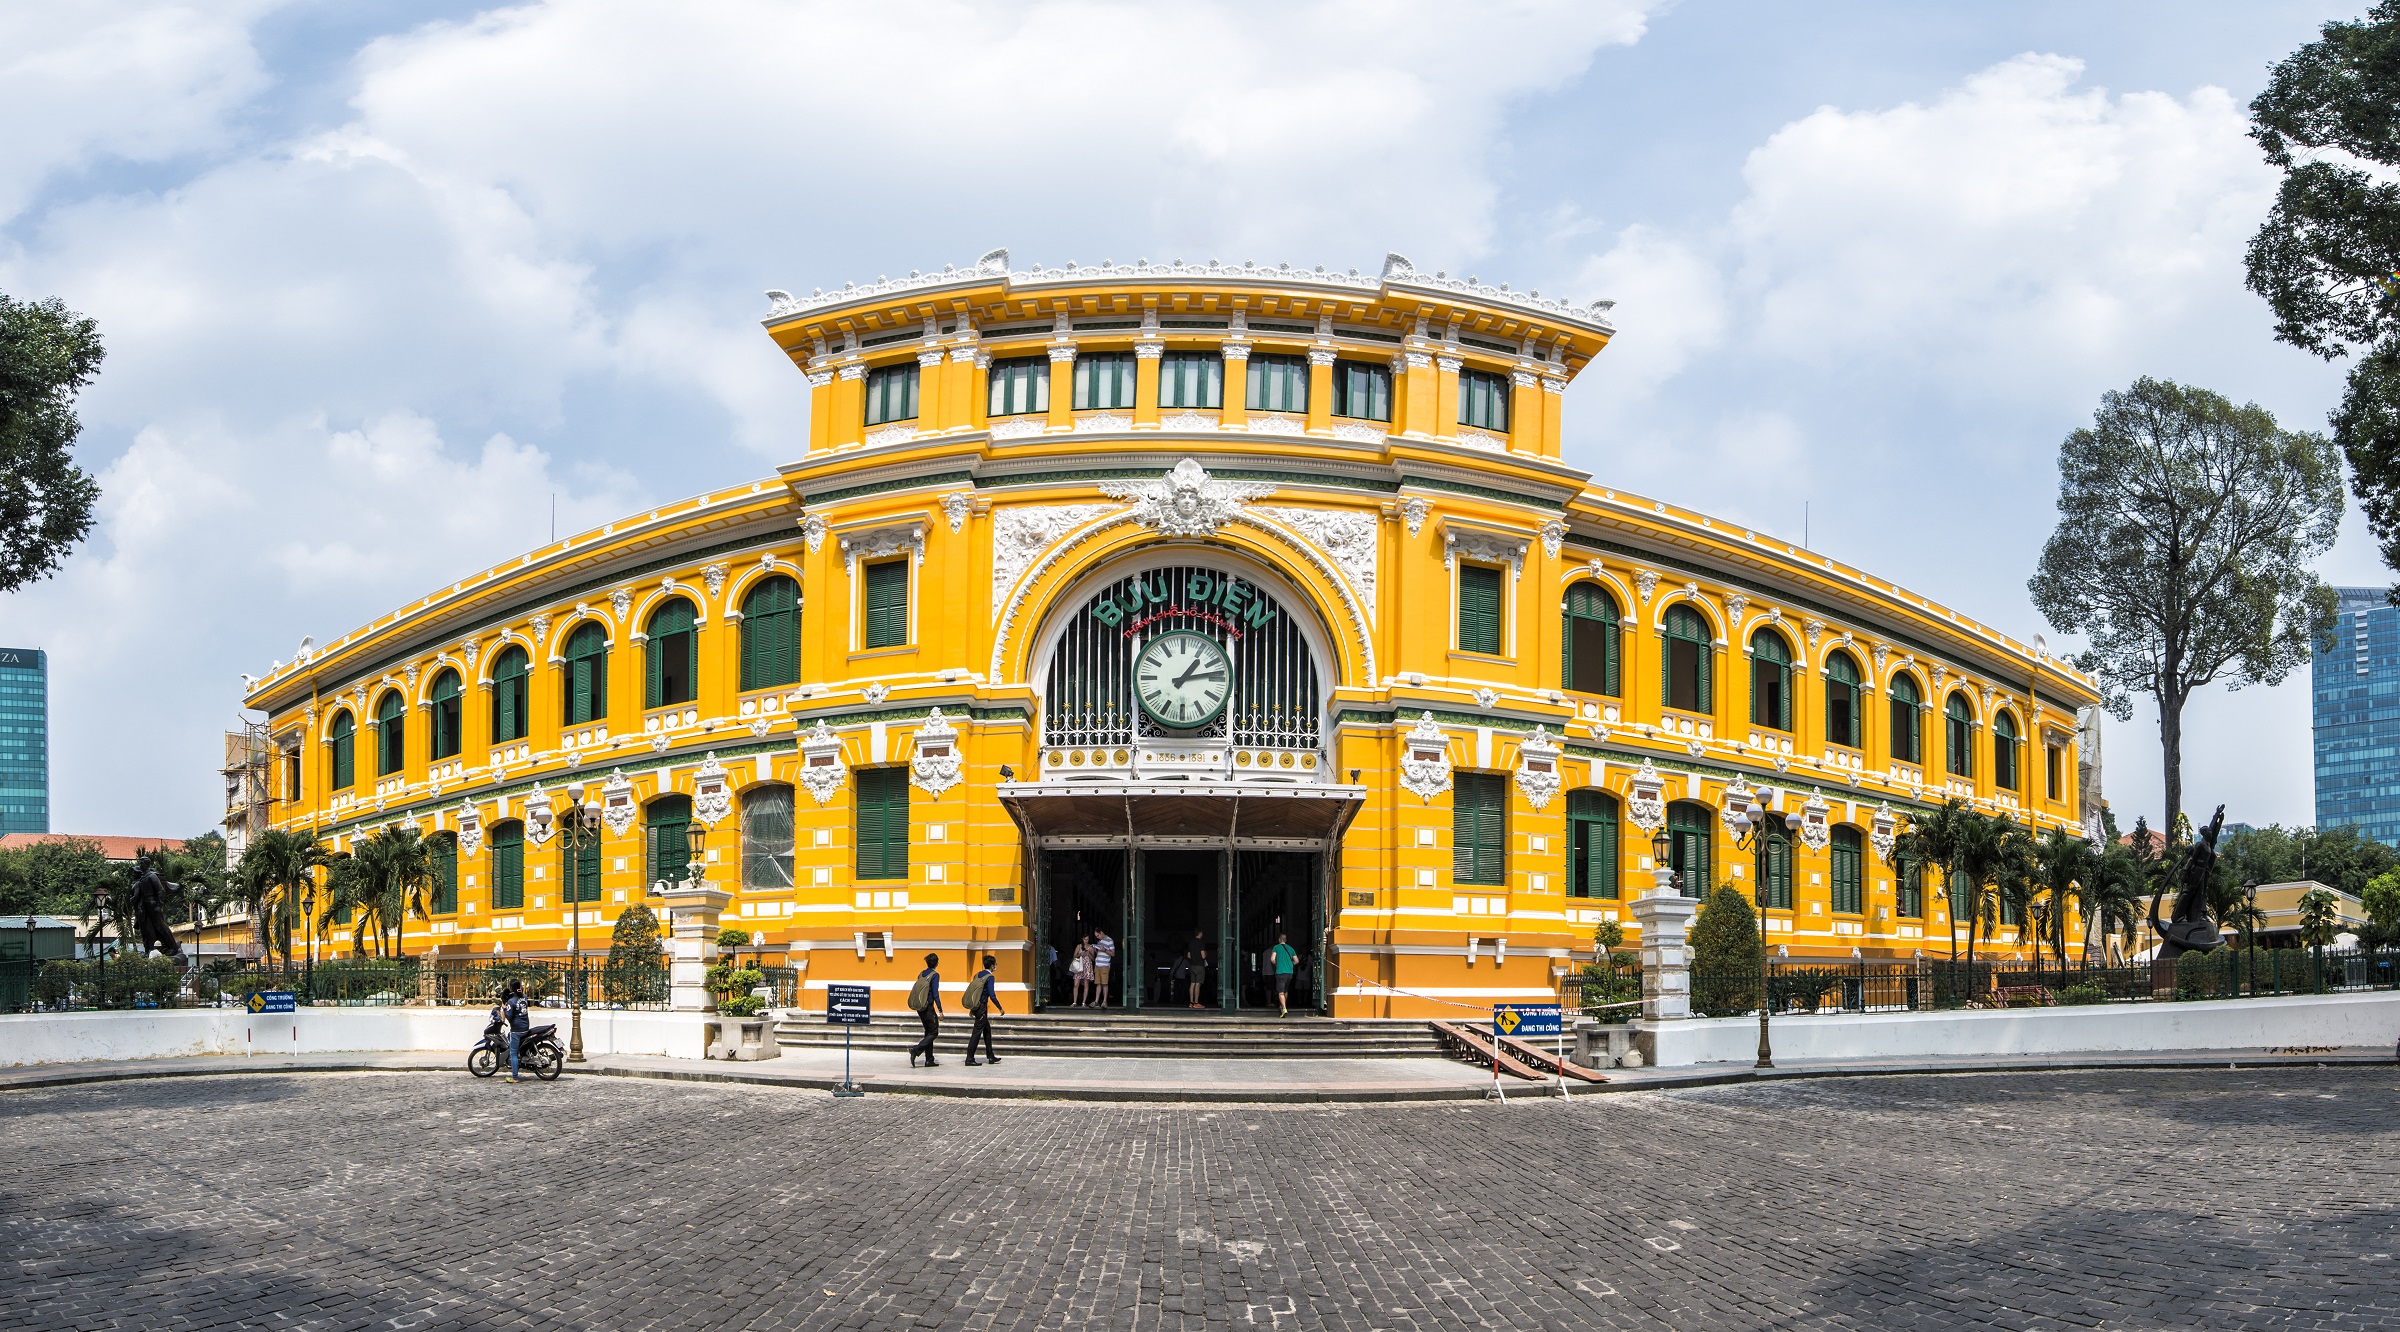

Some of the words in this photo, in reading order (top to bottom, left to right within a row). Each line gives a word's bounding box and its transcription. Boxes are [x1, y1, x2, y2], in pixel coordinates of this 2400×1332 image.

[1092, 576, 1168, 627] BƯU
[1187, 574, 1276, 629] ĐIỆN
[1156, 753, 1176, 762] 1886
[1188, 753, 1206, 763] 1891
[1521, 1024, 1535, 1032] ĐANG
[1536, 1024, 1545, 1032] THI
[1545, 1022, 1560, 1032] CÔNG
